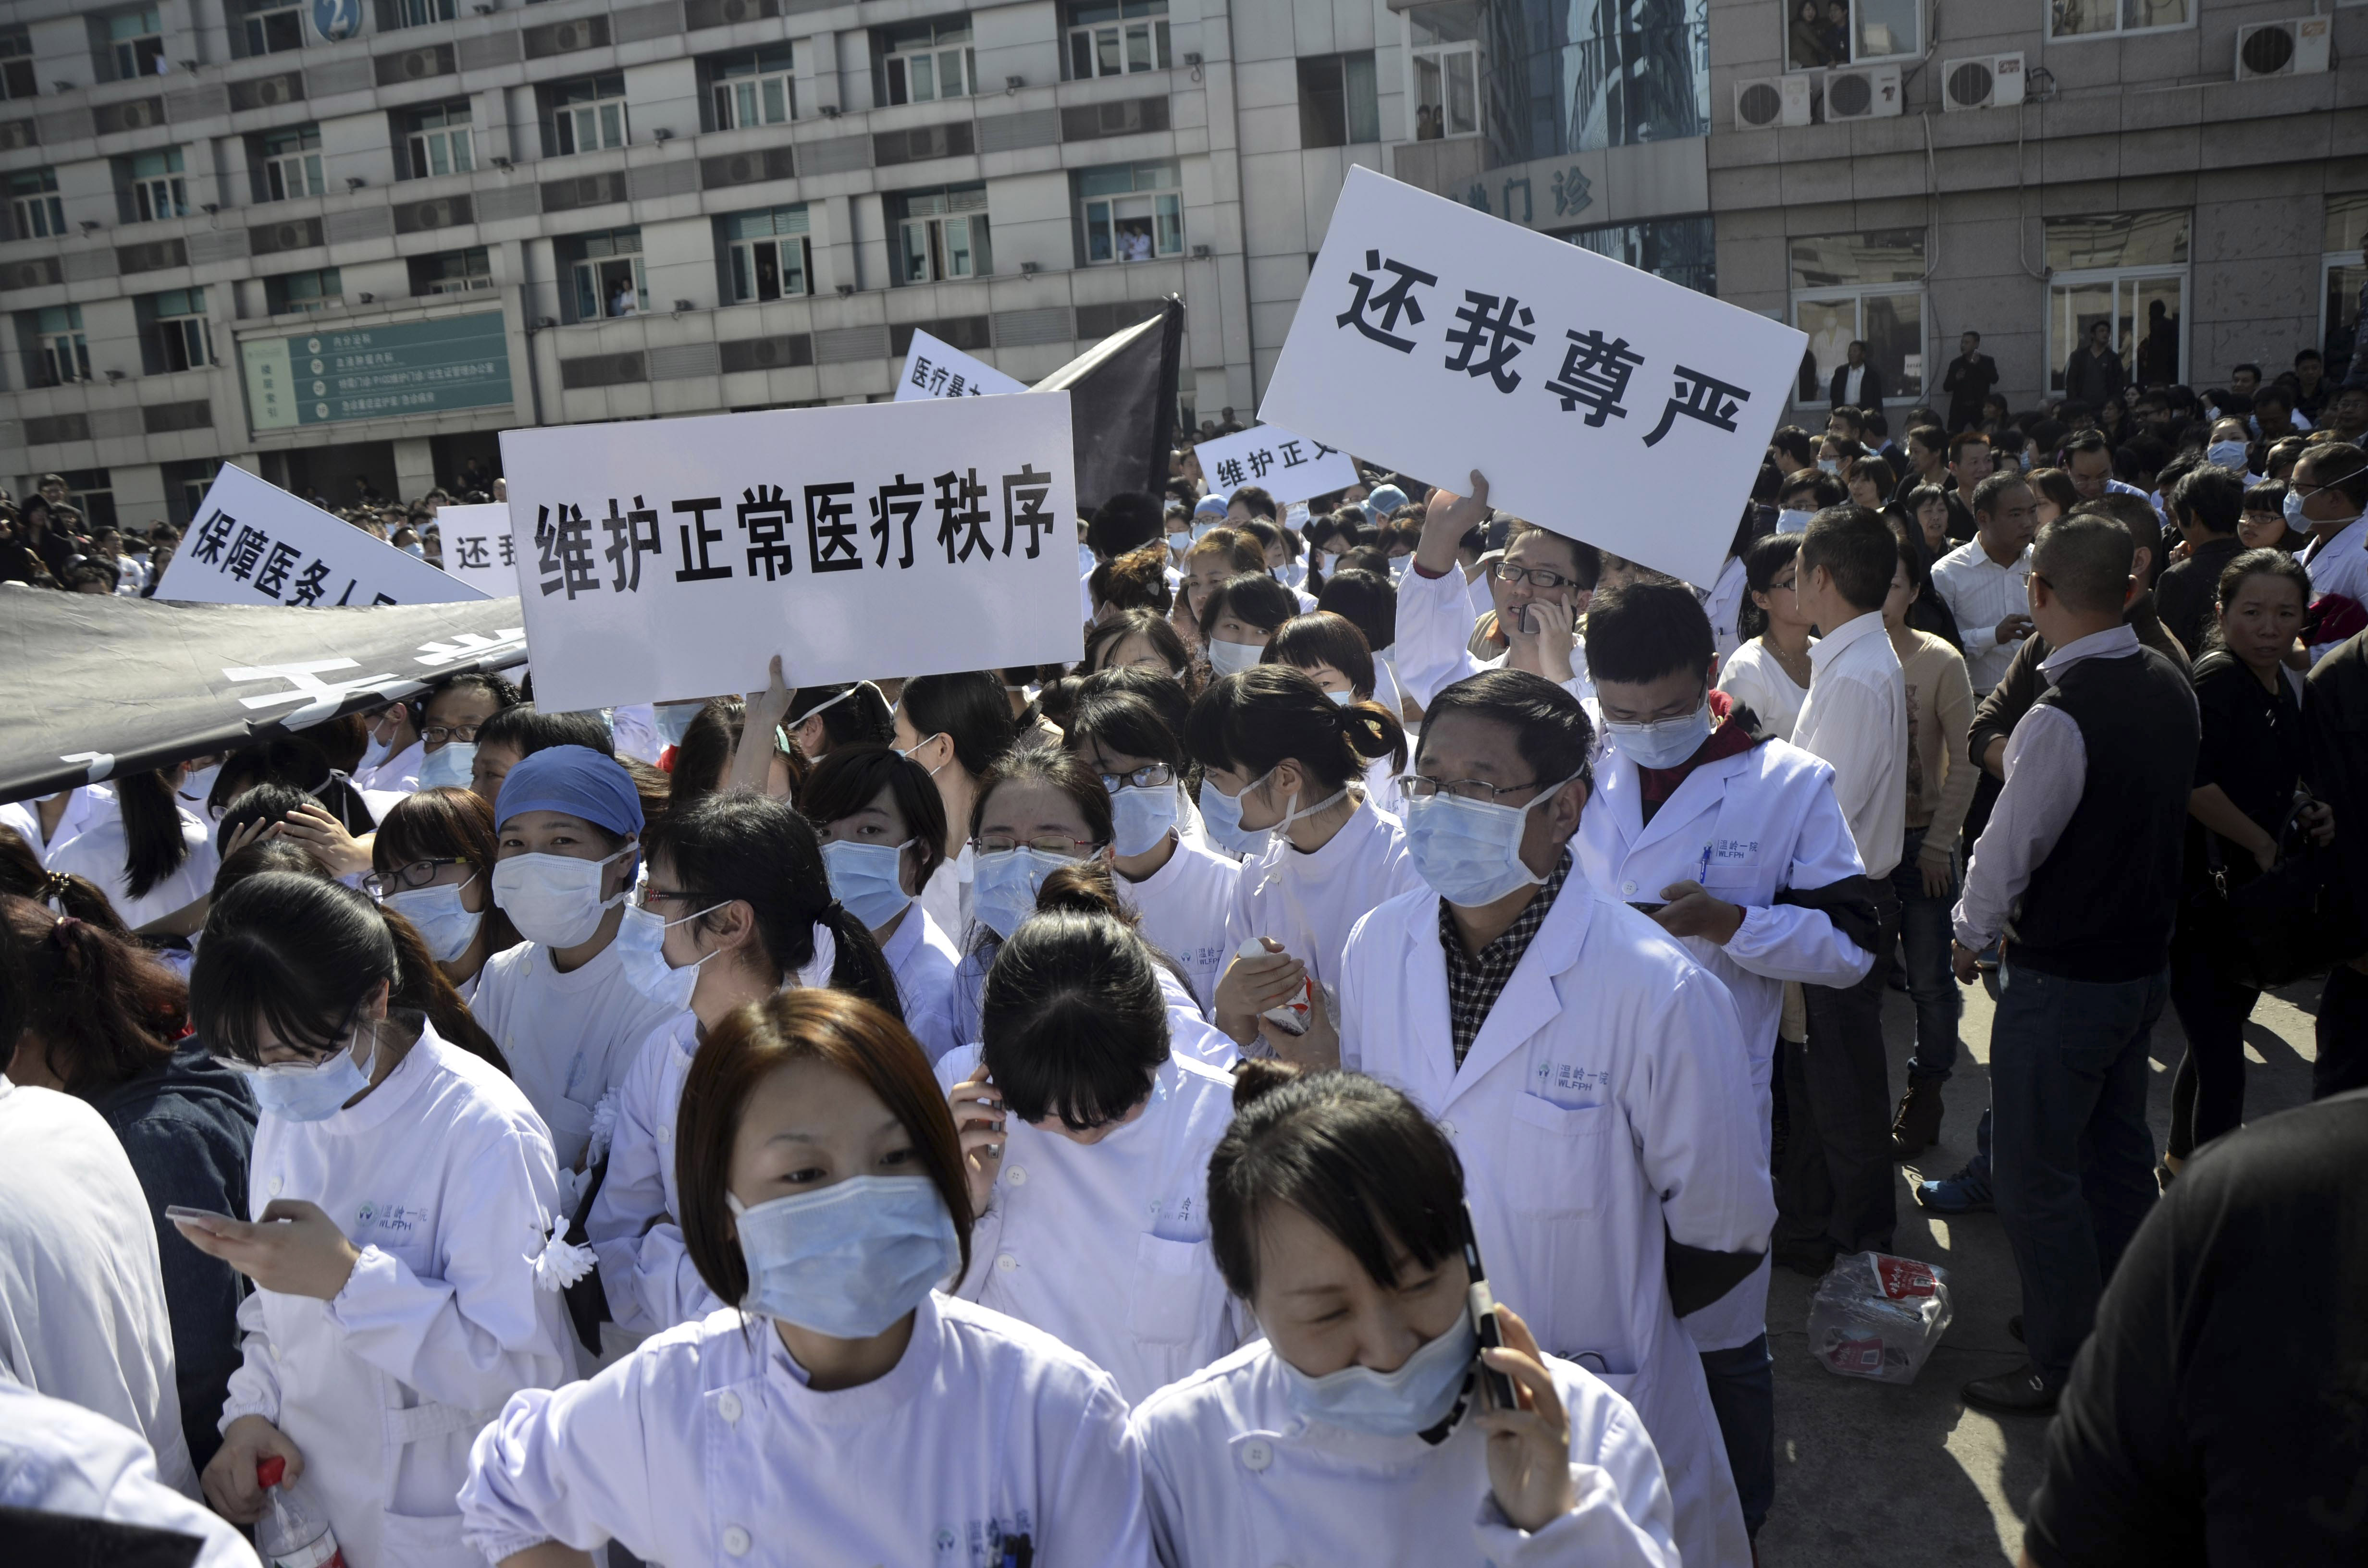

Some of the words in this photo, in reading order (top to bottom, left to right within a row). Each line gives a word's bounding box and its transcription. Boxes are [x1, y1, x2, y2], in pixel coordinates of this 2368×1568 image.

[323, 0, 349, 32] 2
[1336, 248, 1751, 448] 还我尊严
[534, 463, 1055, 600] 维护正常医疗秩序
[1718, 850, 1744, 858] WLFPH
[1719, 840, 1758, 852] 温岭一院
[1558, 1078, 1593, 1091] WLFPH
[1560, 1064, 1609, 1086] 温岭一院
